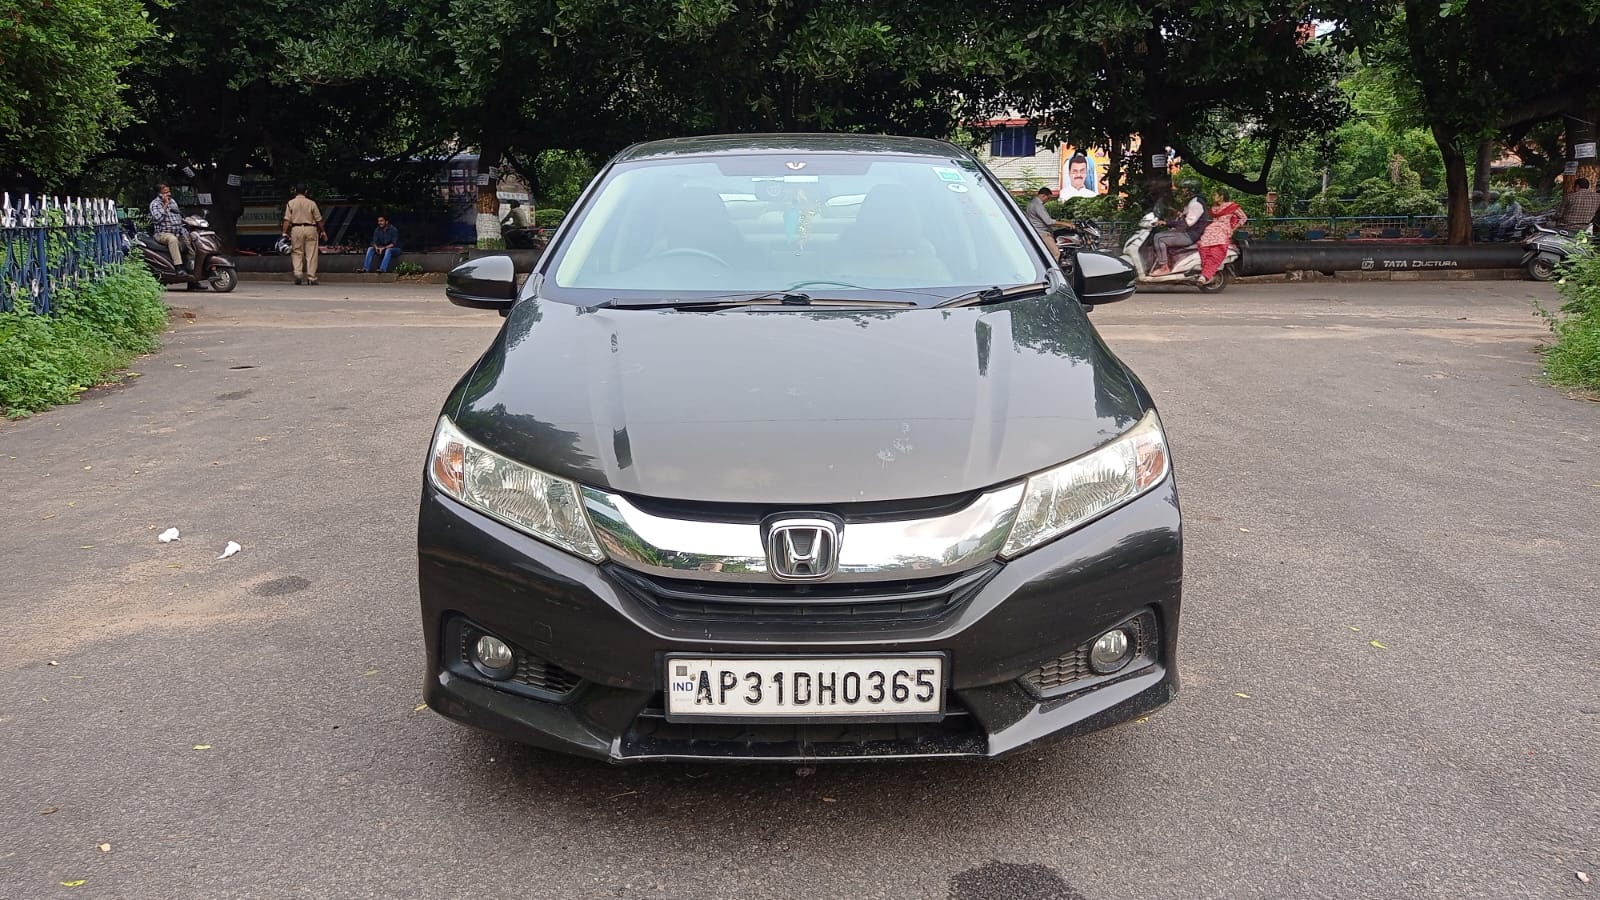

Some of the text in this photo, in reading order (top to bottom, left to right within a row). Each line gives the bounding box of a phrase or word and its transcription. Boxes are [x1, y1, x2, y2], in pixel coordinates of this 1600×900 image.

[1383, 260, 1408, 268] TATA
[672, 681, 694, 692] IND
[695, 669, 935, 704] AP31DH0365
